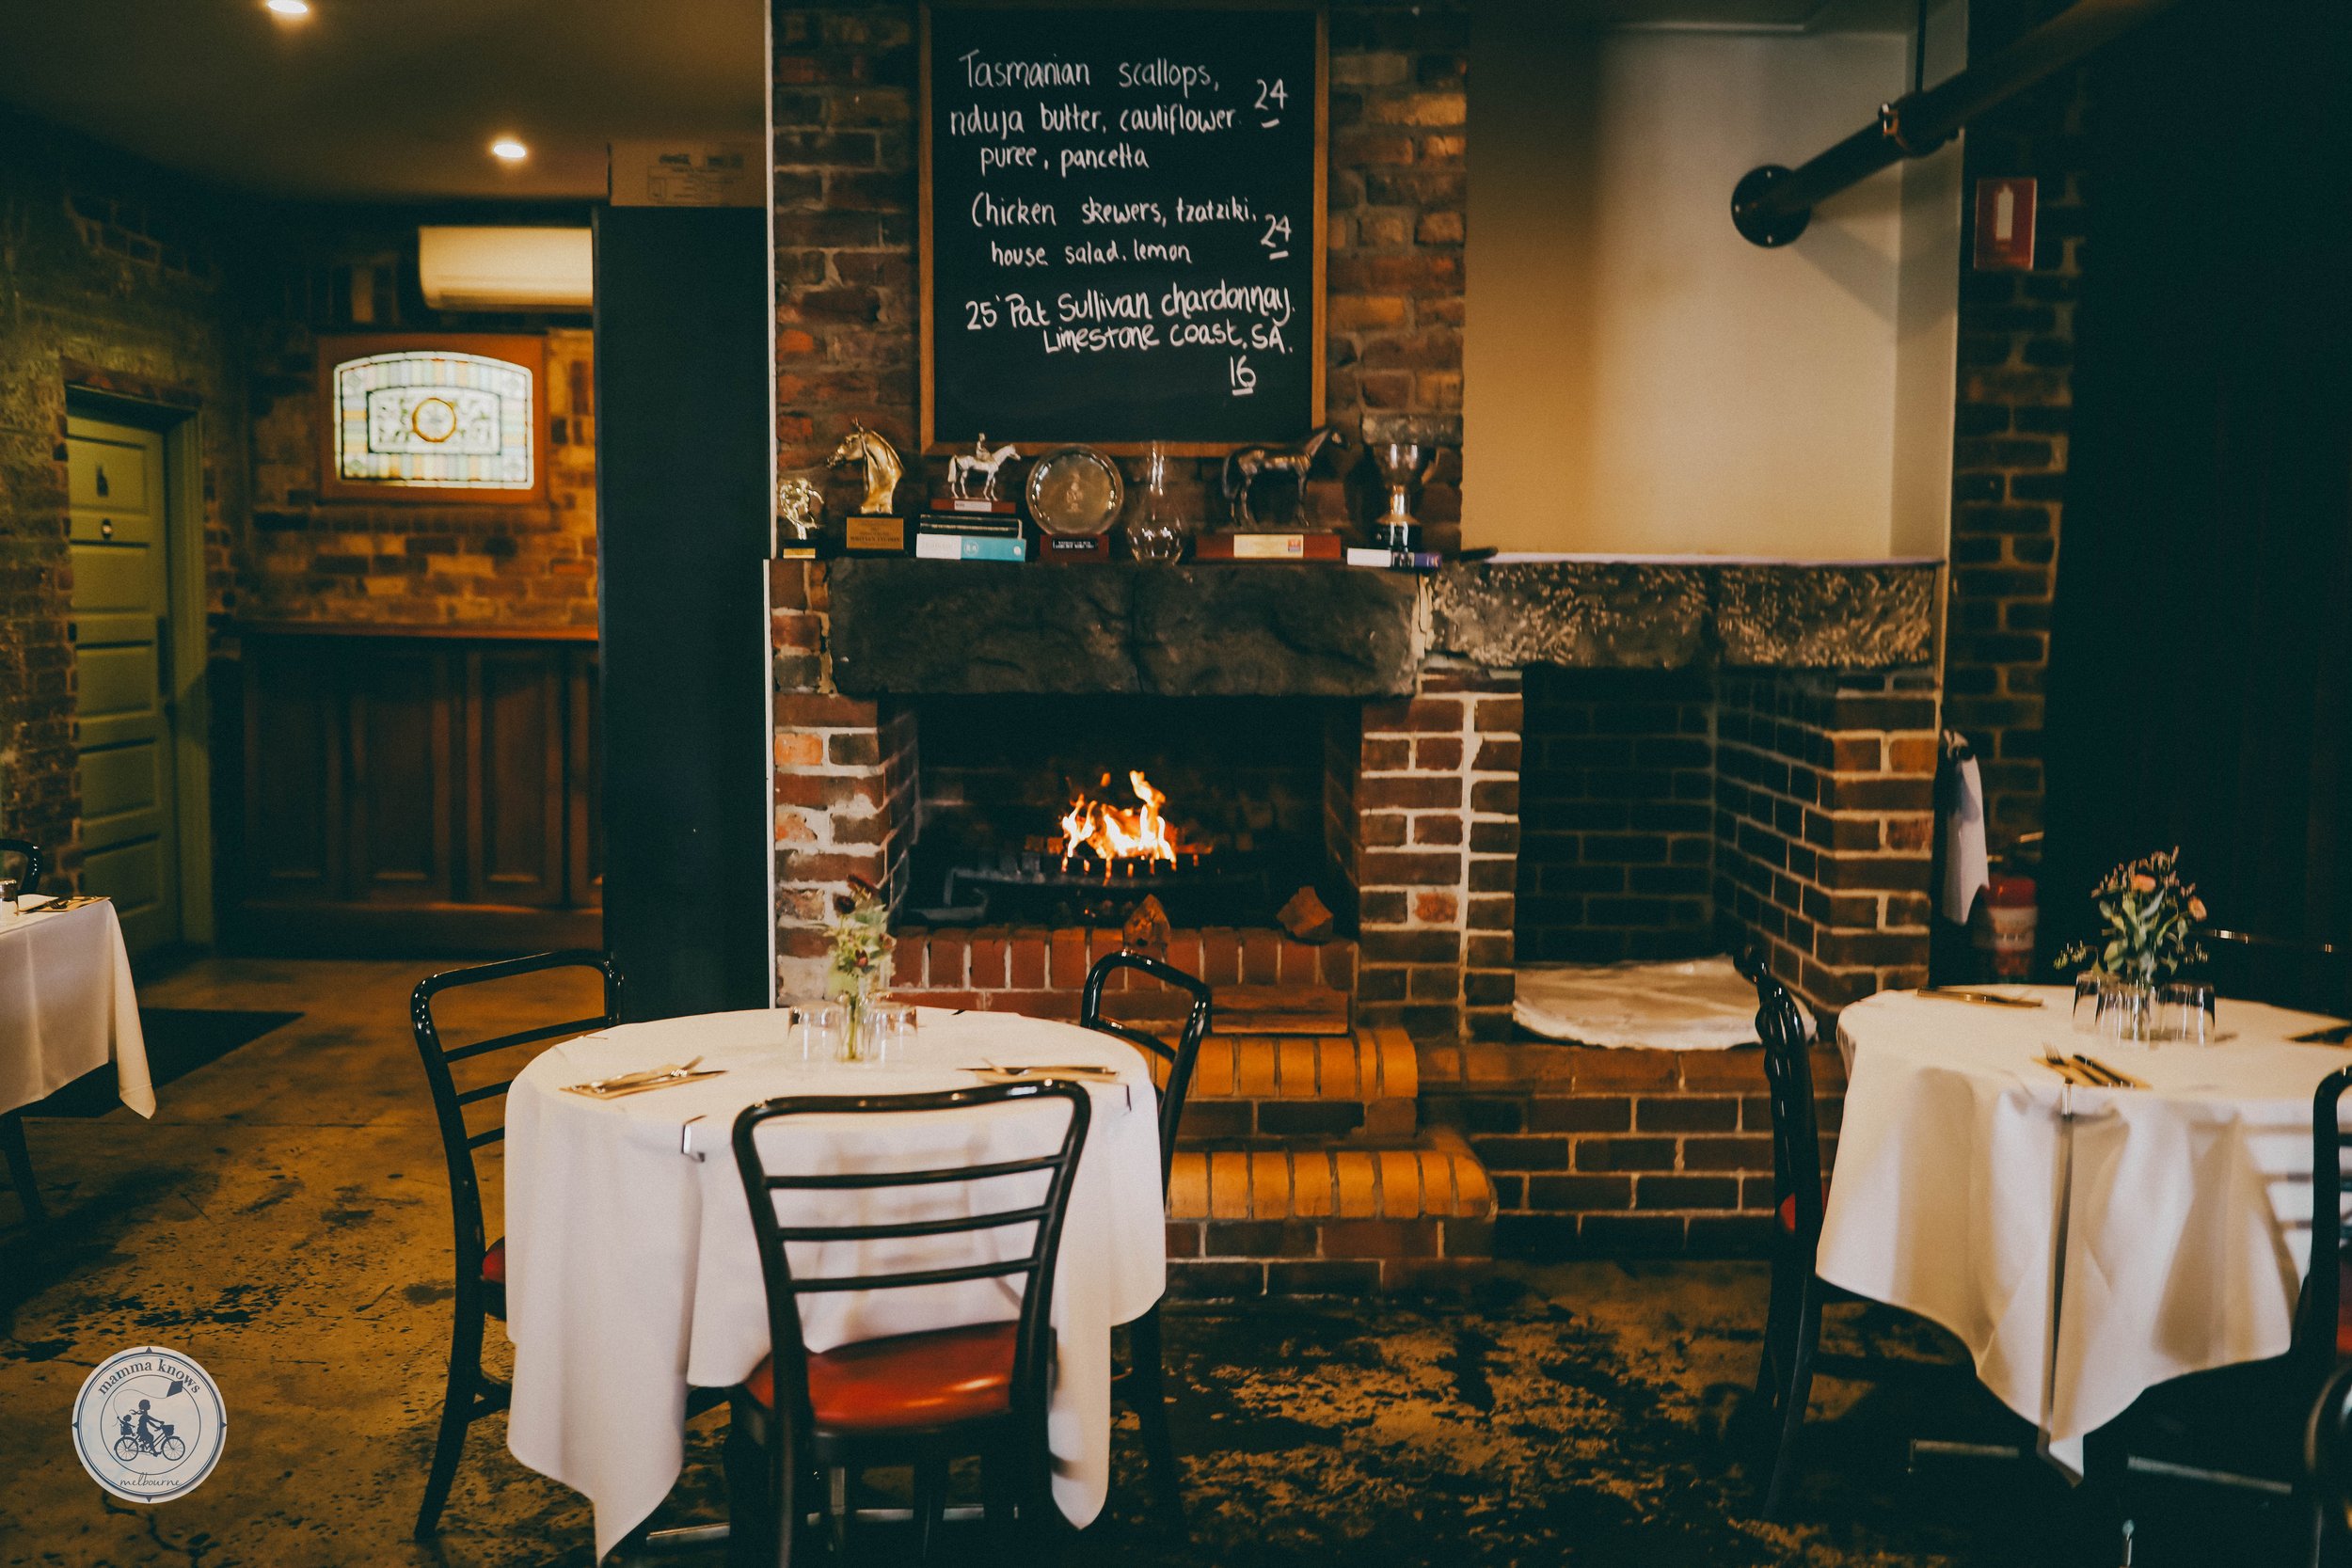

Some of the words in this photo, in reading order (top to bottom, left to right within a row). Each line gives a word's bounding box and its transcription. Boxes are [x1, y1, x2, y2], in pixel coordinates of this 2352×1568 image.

[959, 49, 1091, 89] Tasmanian
[1119, 57, 1219, 99] scallops,
[1254, 78, 1288, 111] 24
[950, 103, 1025, 141] nduja
[1040, 102, 1107, 134] butter,
[1060, 142, 1151, 179] pancetta
[971, 191, 1057, 228] Chicken
[1081, 196, 1167, 229] skewers,
[1260, 214, 1293, 248] 24
[991, 240, 1049, 268] house
[1133, 238, 1194, 264] lemon
[1004, 293, 1051, 329] Pat
[1057, 288, 1153, 324] Sullivan
[1043, 325, 1161, 355] Limestone
[1230, 354, 1257, 388] 16
